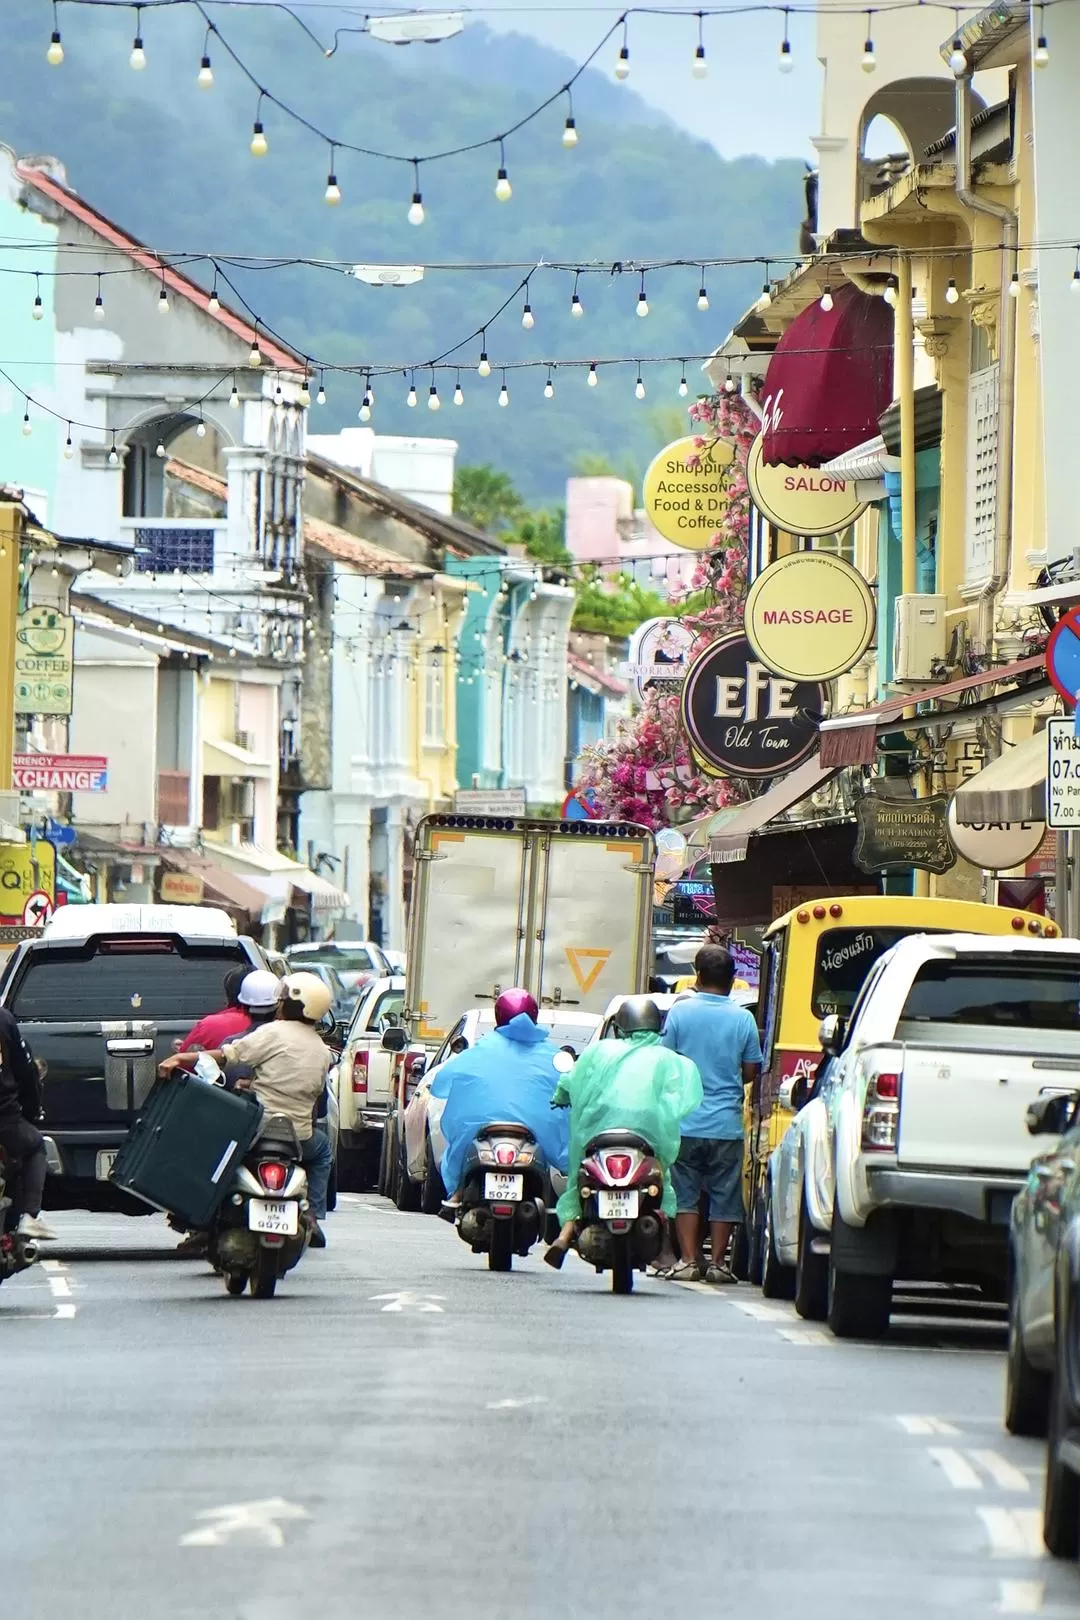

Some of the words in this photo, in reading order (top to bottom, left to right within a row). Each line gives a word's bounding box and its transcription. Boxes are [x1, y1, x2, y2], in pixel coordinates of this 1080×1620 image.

[784, 476, 846, 493] SALON
[654, 498, 690, 511] Food
[694, 498, 704, 511] &
[677, 515, 724, 529] Coffee
[763, 609, 854, 625] MASSAGE
[15, 659, 70, 672] COFFEE
[714, 660, 799, 723] EFE
[724, 725, 753, 748] Old
[758, 725, 791, 749] Town
[1053, 786, 1064, 796] No
[1053, 803, 1075, 817] 7.00
[489, 1191, 517, 1199] 5072
[258, 1220, 289, 1231] 9970
